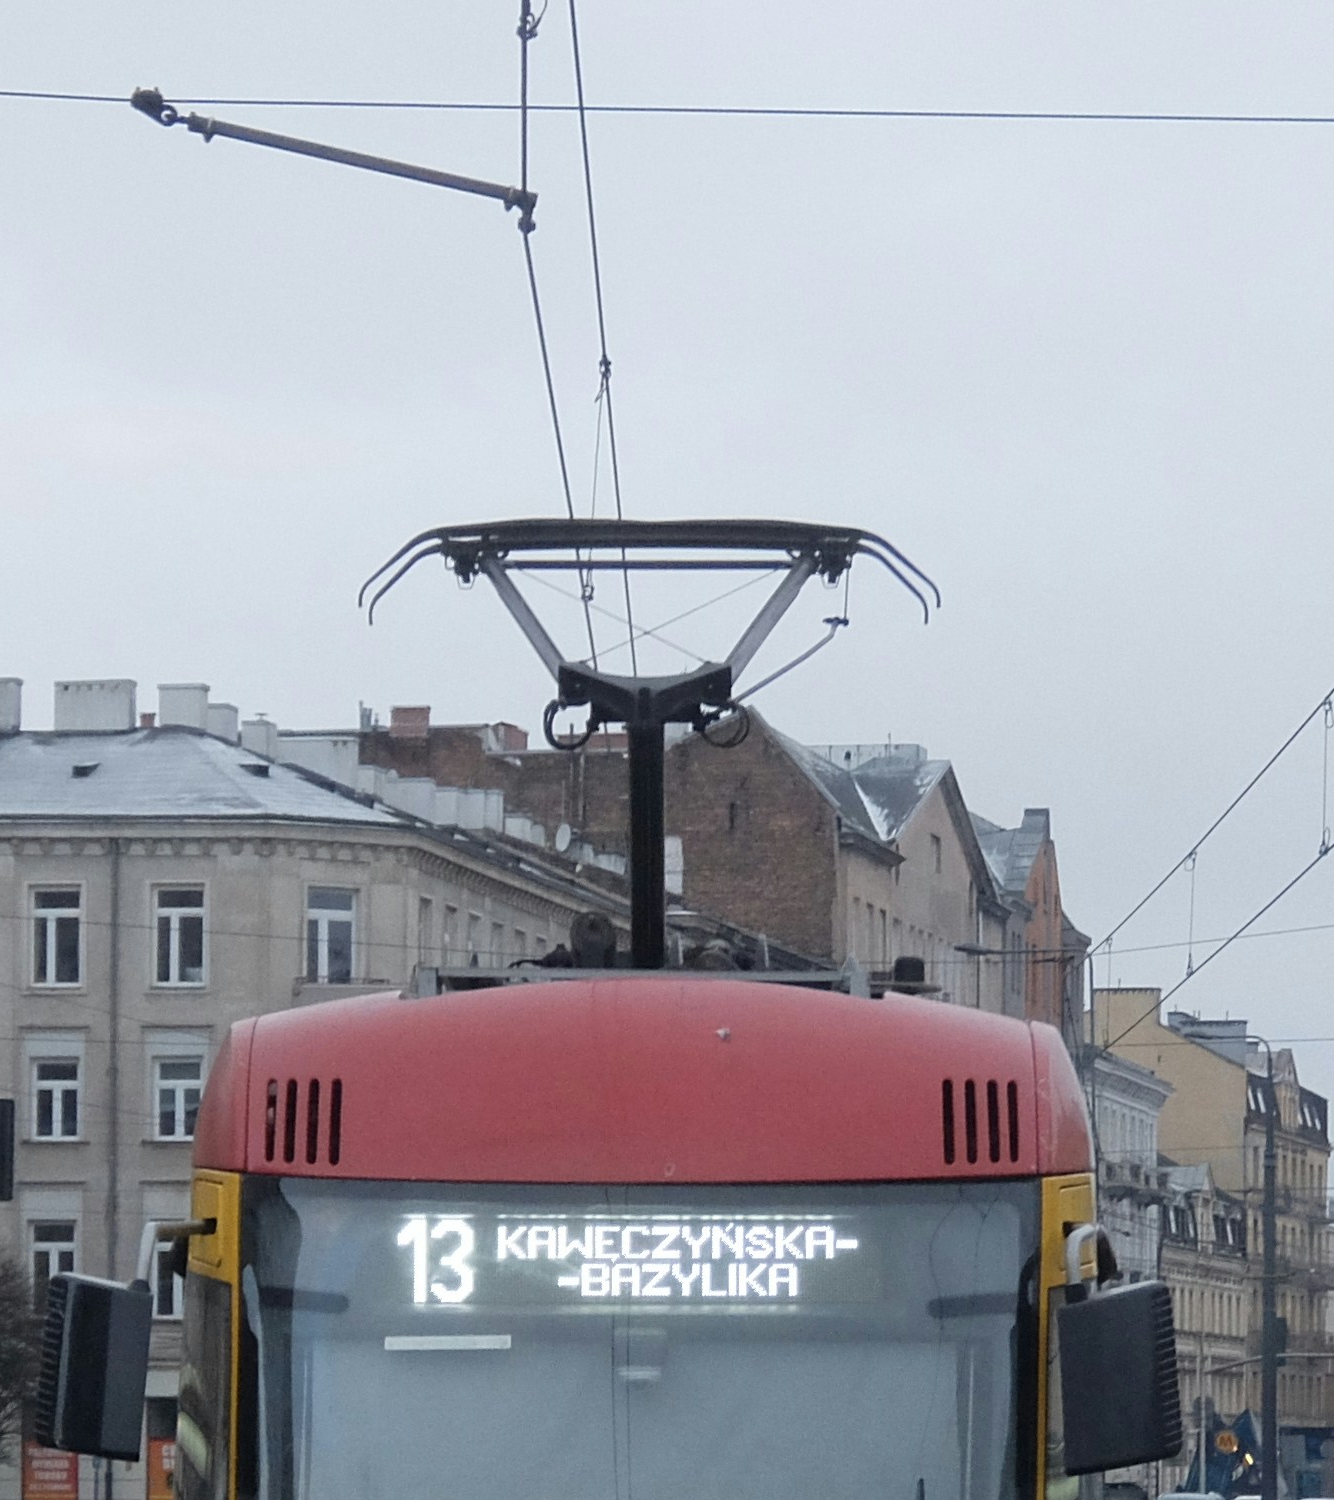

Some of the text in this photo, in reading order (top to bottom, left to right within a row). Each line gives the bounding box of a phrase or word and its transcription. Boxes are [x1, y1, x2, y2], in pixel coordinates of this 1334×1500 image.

[397, 1219, 475, 1302] 13
[496, 1222, 859, 1263] KAWĘCZYŃSKA-
[558, 1263, 798, 1298] -BAZYLIKA
